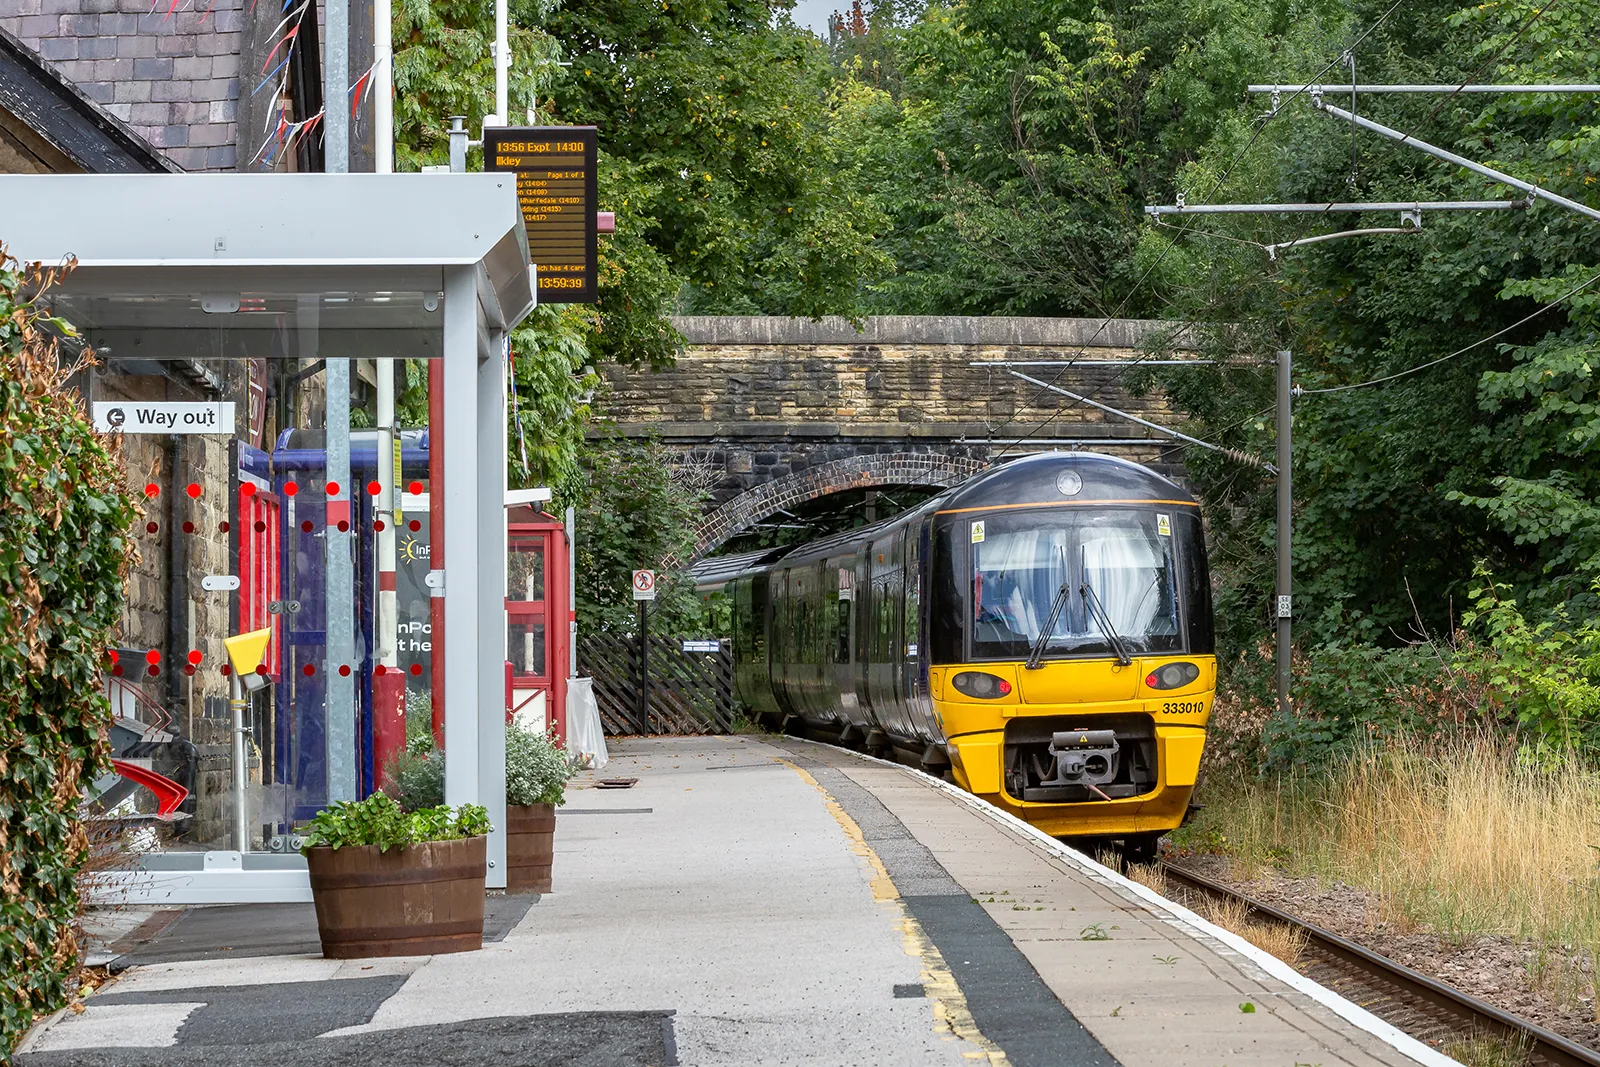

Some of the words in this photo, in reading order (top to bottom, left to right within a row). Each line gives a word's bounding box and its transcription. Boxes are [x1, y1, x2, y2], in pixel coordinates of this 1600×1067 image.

[496, 142, 525, 152] 13:56
[527, 142, 551, 153] Expt
[556, 142, 584, 152] 14:00
[496, 156, 521, 167] Ilkley
[538, 277, 582, 288] 13:59:39
[135, 408, 178, 428] Way
[182, 409, 216, 425] out
[1162, 701, 1204, 714] 333010
